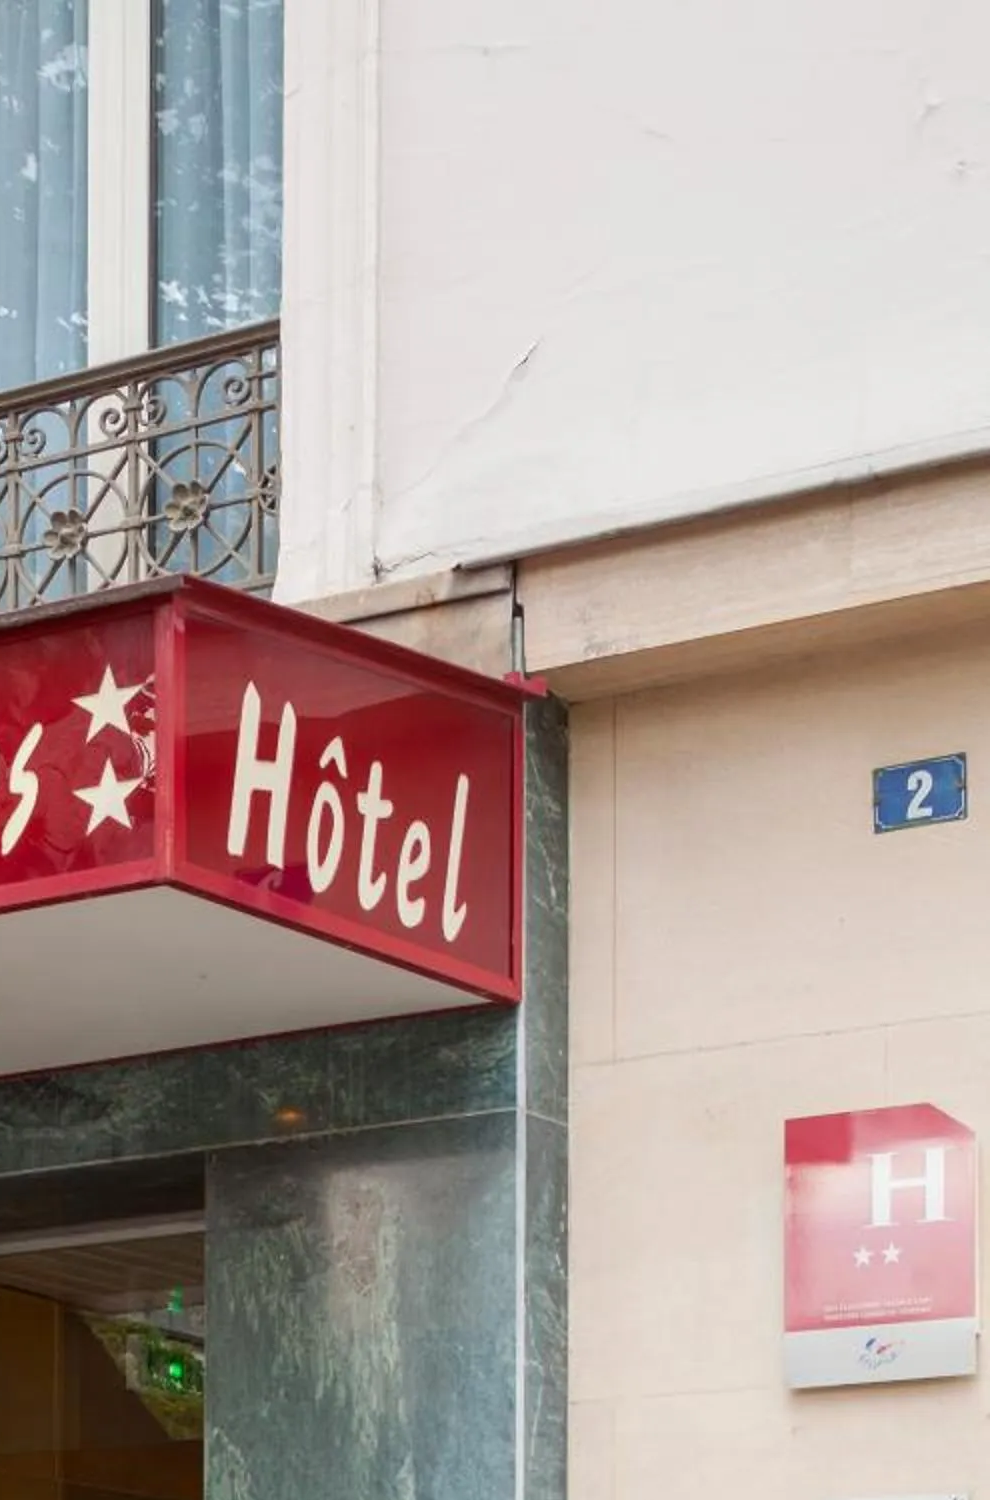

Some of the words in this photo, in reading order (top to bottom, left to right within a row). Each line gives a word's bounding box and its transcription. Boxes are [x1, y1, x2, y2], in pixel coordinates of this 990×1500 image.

[227, 681, 469, 942] Hôtel
[906, 770, 933, 820] 2
[863, 1145, 956, 1227] H
